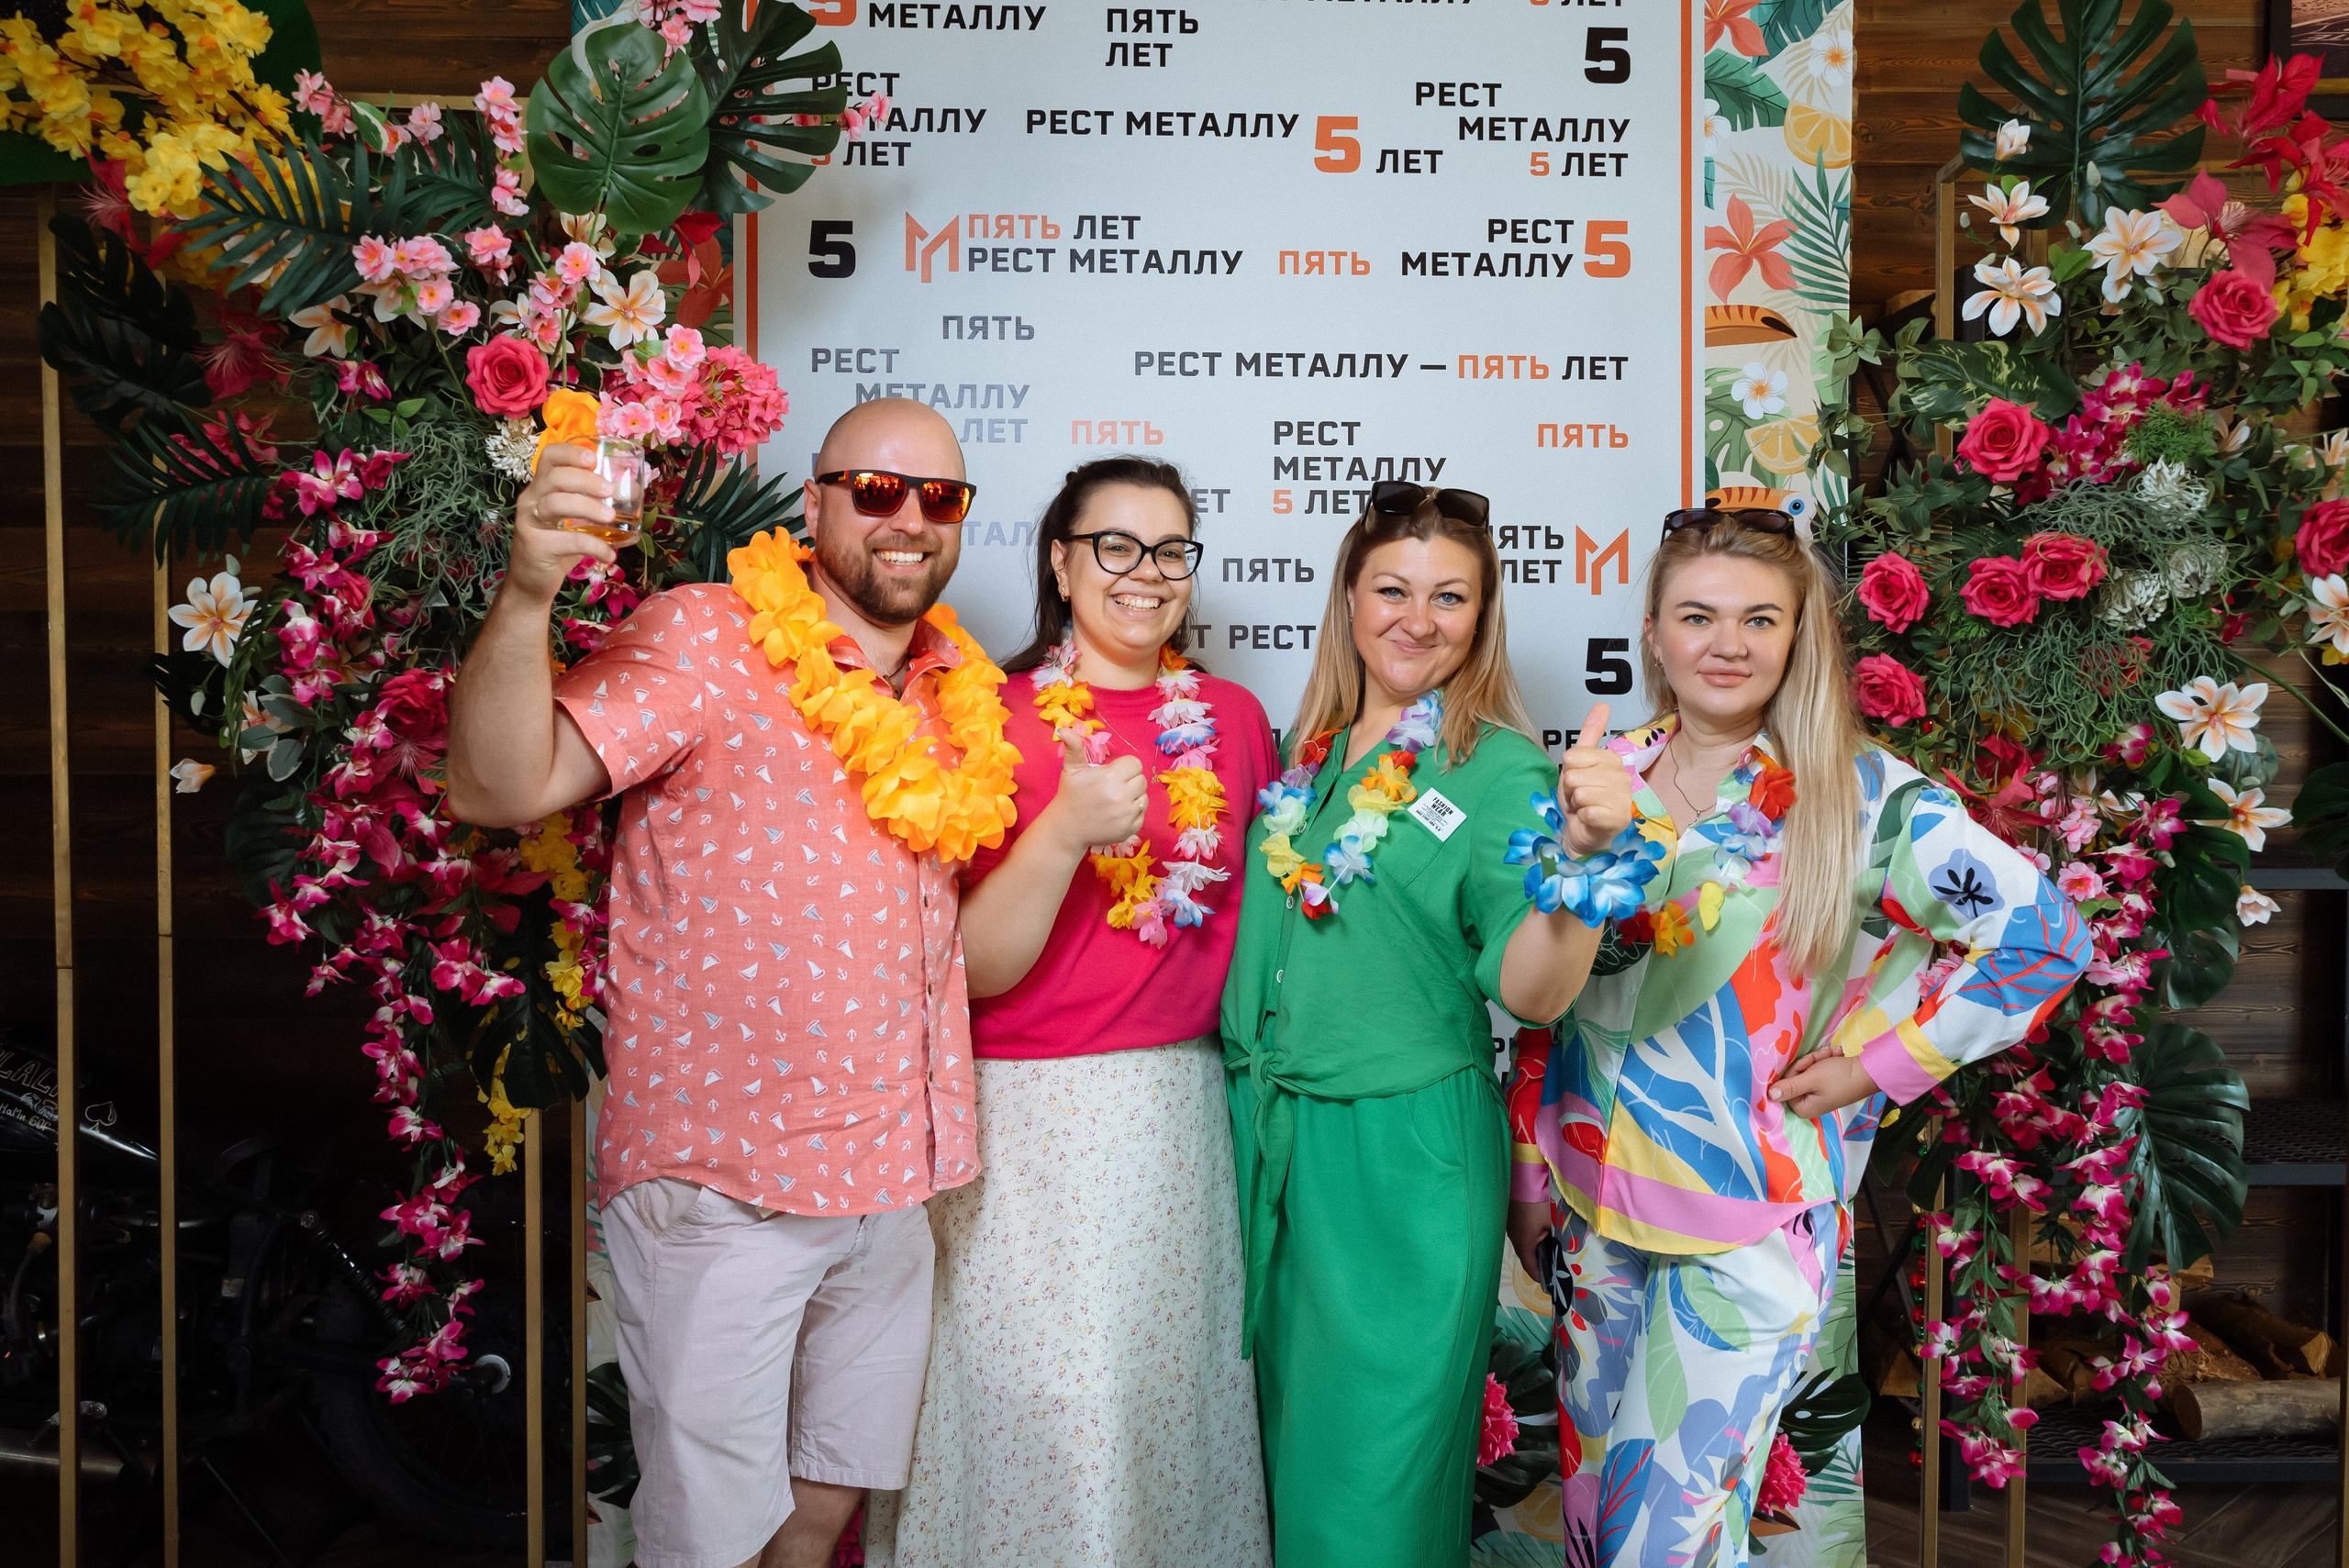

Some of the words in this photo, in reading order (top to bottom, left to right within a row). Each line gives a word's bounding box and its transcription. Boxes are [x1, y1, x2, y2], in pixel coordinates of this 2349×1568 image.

[870, 3, 1046, 30] МЕТАЛЛУ
[1108, 9, 1198, 33] ПЯТЬ
[1106, 43, 1173, 67] ЛЕТ
[1585, 28, 1631, 83] 5
[1416, 83, 1501, 106] РЕСТ
[849, 106, 987, 133] АЛЛУ
[1027, 110, 1114, 135] РЕСТ
[1127, 112, 1298, 138] МЕТАЛЛУ
[1460, 117, 1630, 142] МЕТАЛЛУ
[842, 141, 912, 167] ЛЕТ
[1314, 117, 1361, 172] 5
[1376, 150, 1442, 173] ЛЕТ
[1531, 152, 1549, 176] 5
[1562, 152, 1628, 176] ЛЕТ
[969, 215, 1060, 239] ПЯТЬ
[1074, 216, 1141, 239] ЛЕТ
[1488, 219, 1574, 243] РЕСТ
[808, 220, 855, 278] 5
[969, 248, 1055, 272] РЕСТ
[1070, 249, 1242, 274] МЕТАЛЛУ
[1584, 221, 1631, 278] 5
[1280, 251, 1370, 275] ПЯТЬ
[1402, 252, 1573, 277] МЕТАЛЛУ
[943, 316, 1034, 339] ПЯТЬ
[812, 349, 899, 373] РЕСТ
[1135, 351, 1221, 376] РЕСТ
[1236, 353, 1408, 377] МЕТАЛЛУ
[1459, 355, 1549, 379] ПЯТЬ
[1563, 356, 1628, 380] ЛЕТ
[959, 418, 1028, 443] ЛЕТ
[1072, 420, 1164, 445] ПЯТЬ
[1275, 421, 1361, 445] РЕСТ
[1538, 424, 1628, 448] ПЯТЬ
[1274, 456, 1447, 482] МЕТАЛЛУ
[1191, 489, 1231, 513] ЕТ
[1274, 490, 1292, 514] 5
[1305, 490, 1370, 514] ЛЕТ
[1489, 526, 1564, 550] ЯТЬ
[1223, 559, 1314, 582] ПЯТЬ
[1501, 560, 1563, 584] ЛЕТ
[1230, 625, 1316, 649] РЕСТ
[1586, 639, 1632, 695] 5
[1431, 802, 1447, 817] WEAR
[1432, 796, 1454, 816] FASHION
